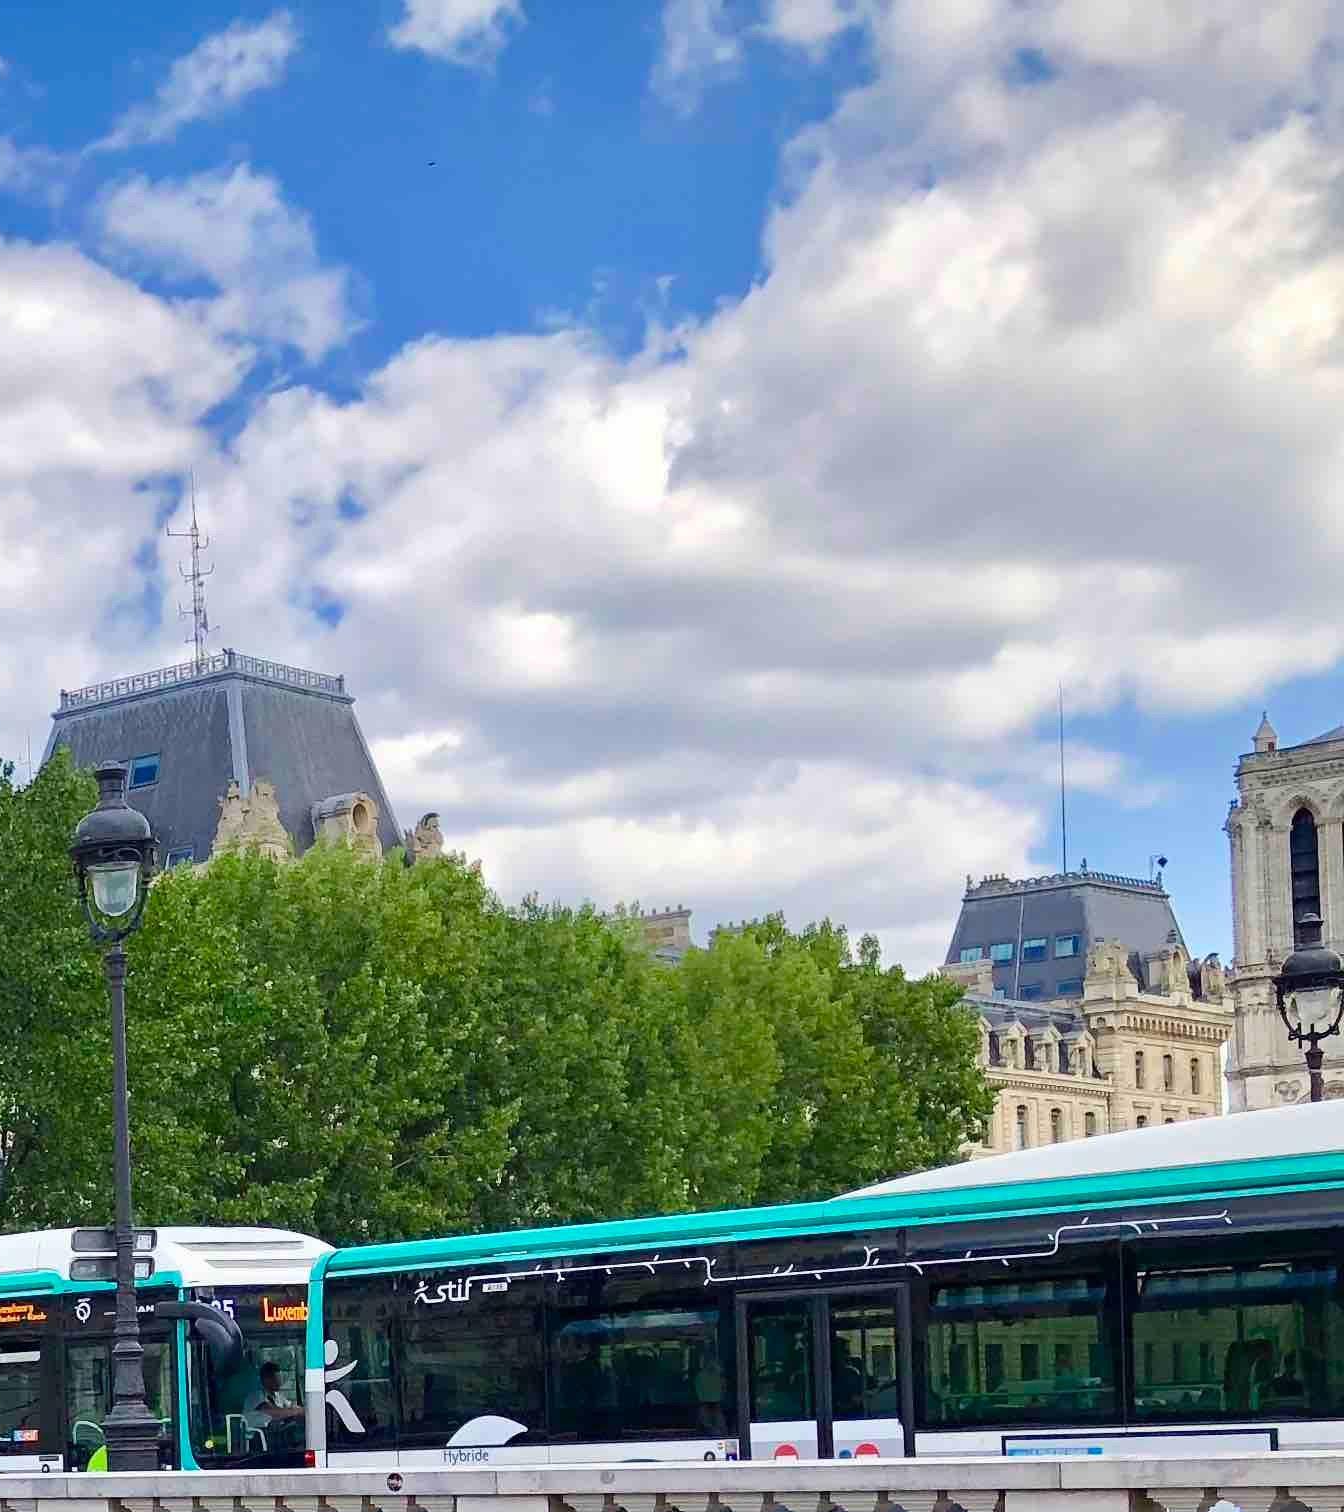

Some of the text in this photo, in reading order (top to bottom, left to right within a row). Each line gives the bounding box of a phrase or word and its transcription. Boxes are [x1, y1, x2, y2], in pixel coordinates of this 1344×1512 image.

[436, 1278, 472, 1303] stif
[135, 1304, 155, 1313] AN
[443, 1448, 489, 1465] Hybride
